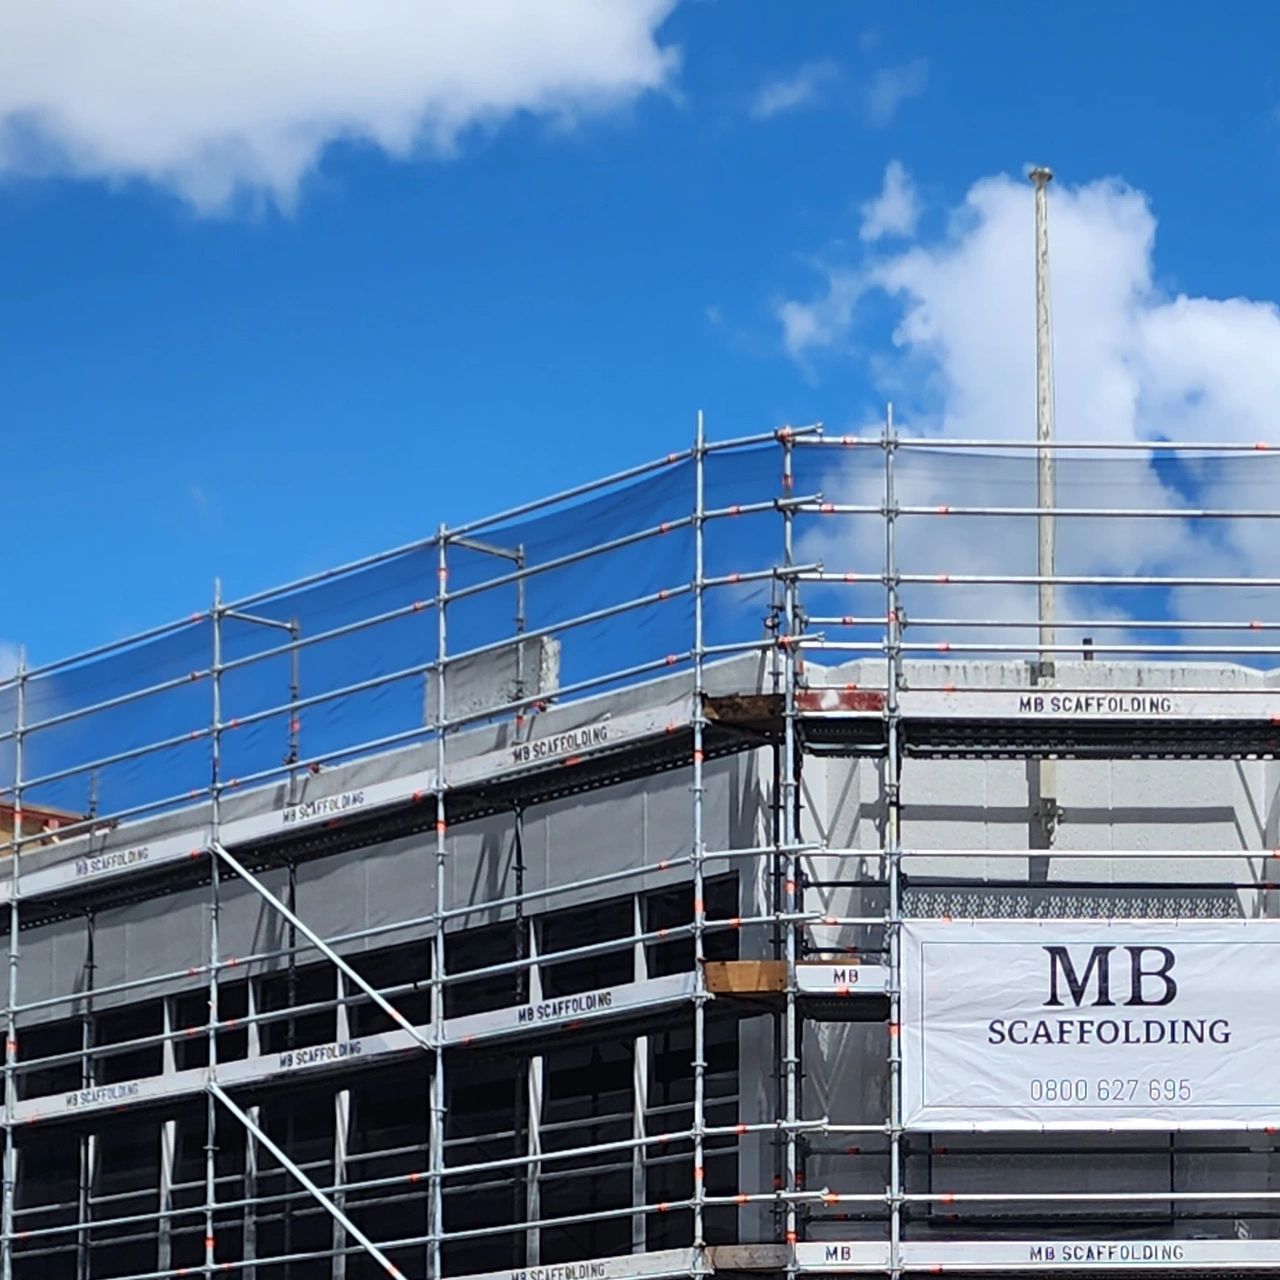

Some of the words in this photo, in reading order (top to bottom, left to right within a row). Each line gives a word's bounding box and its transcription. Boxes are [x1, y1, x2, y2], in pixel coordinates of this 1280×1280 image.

[1019, 697, 1044, 712] MB
[1051, 697, 1171, 712] SCAFFOLDING
[514, 745, 530, 763] MB
[533, 727, 608, 757] SCAFFOLDING
[283, 811, 296, 823] MB
[299, 792, 364, 820] SCAFFOLDING
[90, 848, 149, 872] SCAFFOLDING
[833, 969, 859, 984] MB
[1042, 945, 1177, 1007] MB
[518, 1008, 534, 1022] MB
[537, 992, 612, 1020] SCAFFOLDING
[988, 1018, 1231, 1046] SCAFFOLDING
[279, 1054, 293, 1068] MB
[295, 1042, 361, 1065] SCAFFOLDING
[79, 1083, 139, 1104] SCAFFOLDING
[1030, 1079, 1088, 1102] 0800
[1097, 1079, 1138, 1102] 627
[1149, 1079, 1192, 1102] 695
[825, 1246, 851, 1261] MB
[1030, 1247, 1055, 1261] MB
[1062, 1245, 1184, 1261] SCAFFOLDING
